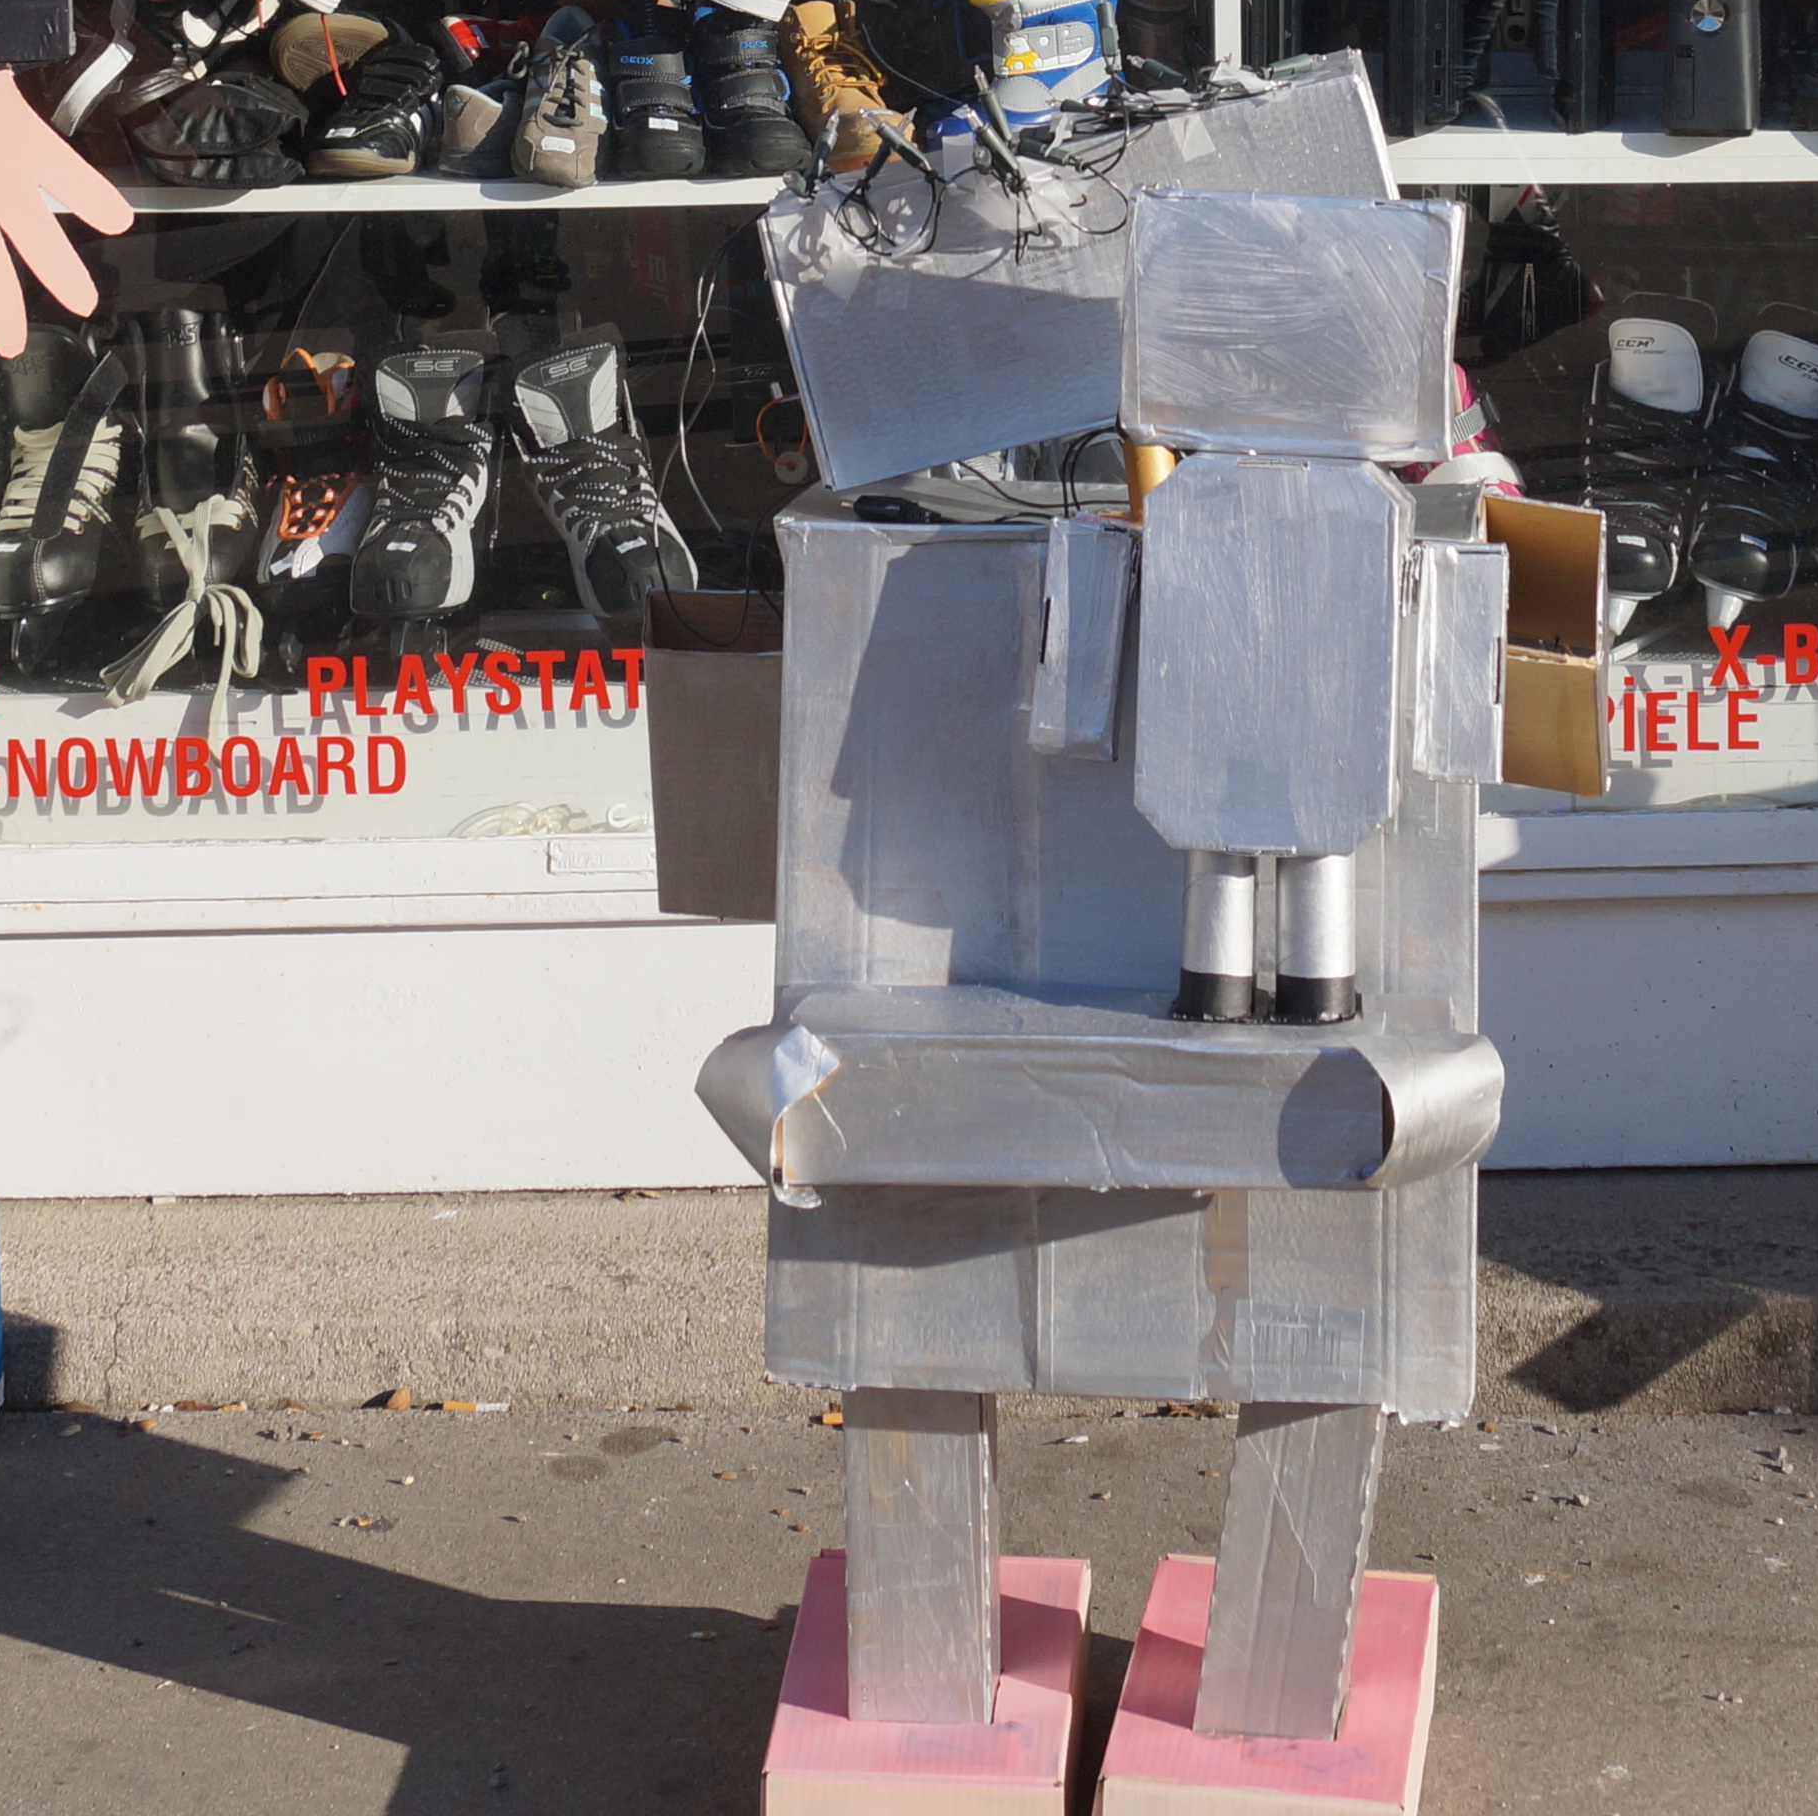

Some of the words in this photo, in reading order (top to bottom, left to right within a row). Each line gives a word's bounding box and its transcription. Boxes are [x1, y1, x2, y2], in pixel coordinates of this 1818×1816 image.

[620, 55, 655, 66] GEOX
[1615, 338, 1651, 349] CCM
[304, 646, 646, 719] PLAYSTAT
